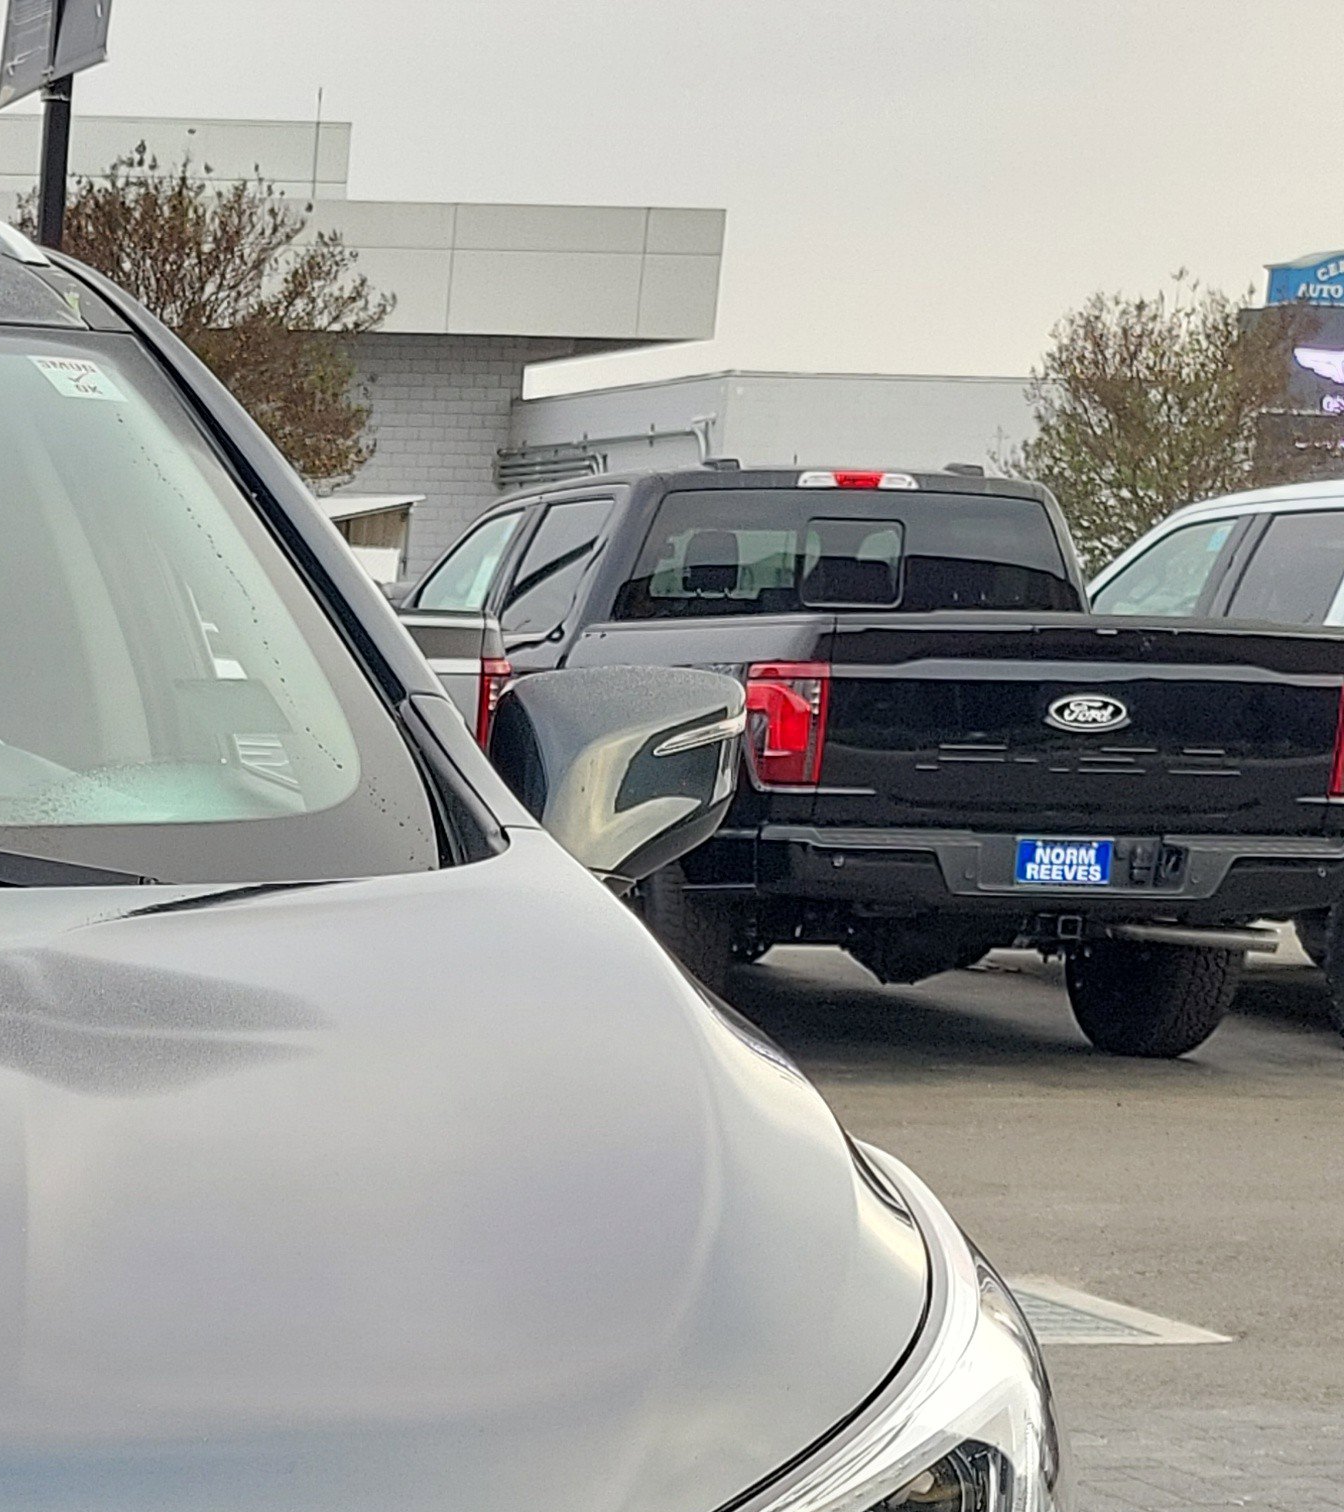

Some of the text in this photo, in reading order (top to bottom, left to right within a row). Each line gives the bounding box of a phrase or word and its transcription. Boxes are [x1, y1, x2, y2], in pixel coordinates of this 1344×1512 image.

[1297, 283, 1343, 299] AUTO
[1063, 700, 1115, 722] Ford
[1034, 846, 1097, 865] NORM
[1025, 862, 1103, 882] REEVES
